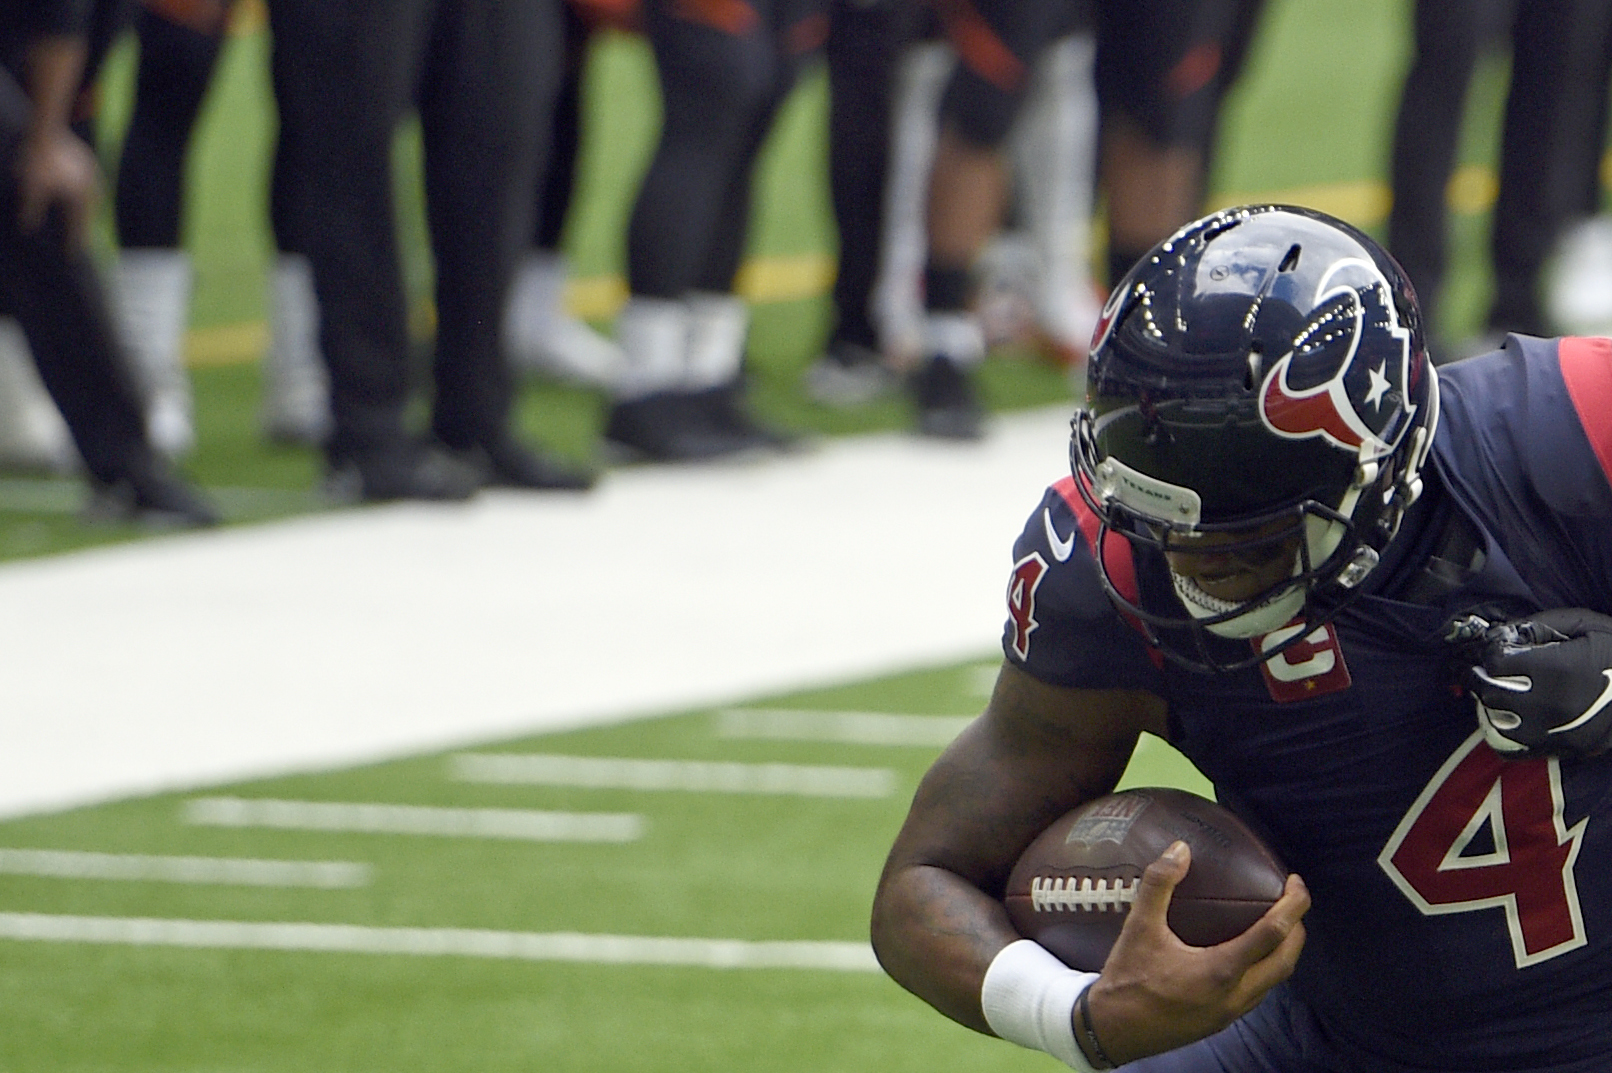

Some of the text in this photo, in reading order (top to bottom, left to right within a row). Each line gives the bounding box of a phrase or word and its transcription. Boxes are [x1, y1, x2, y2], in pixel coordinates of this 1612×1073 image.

[1005, 550, 1050, 662] 4
[1261, 622, 1336, 682] C
[1376, 727, 1590, 969] 4
